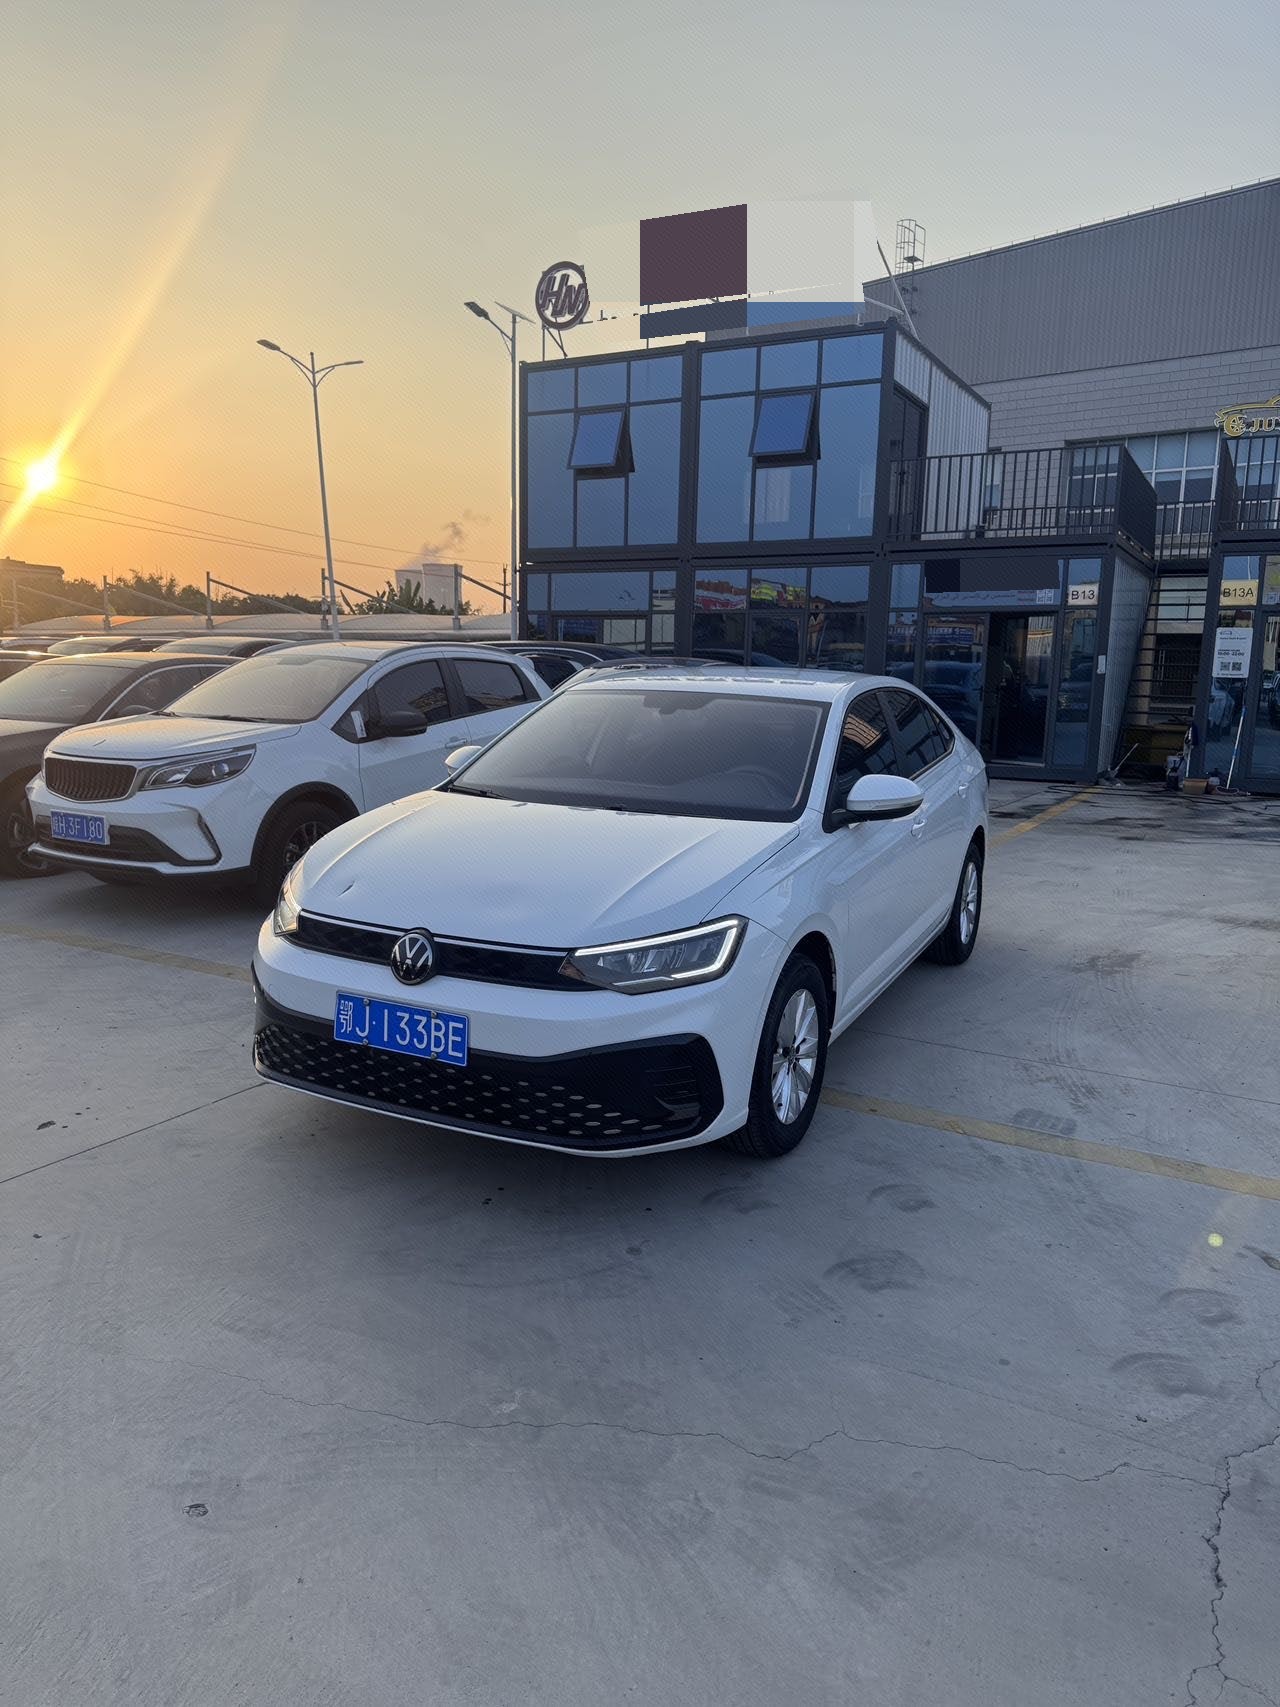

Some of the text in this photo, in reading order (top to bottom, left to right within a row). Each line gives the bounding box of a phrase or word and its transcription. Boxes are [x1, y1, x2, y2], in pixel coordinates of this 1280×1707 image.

[1248, 416, 1280, 433] JU
[1071, 589, 1096, 600] B13
[1222, 587, 1255, 598] B13A
